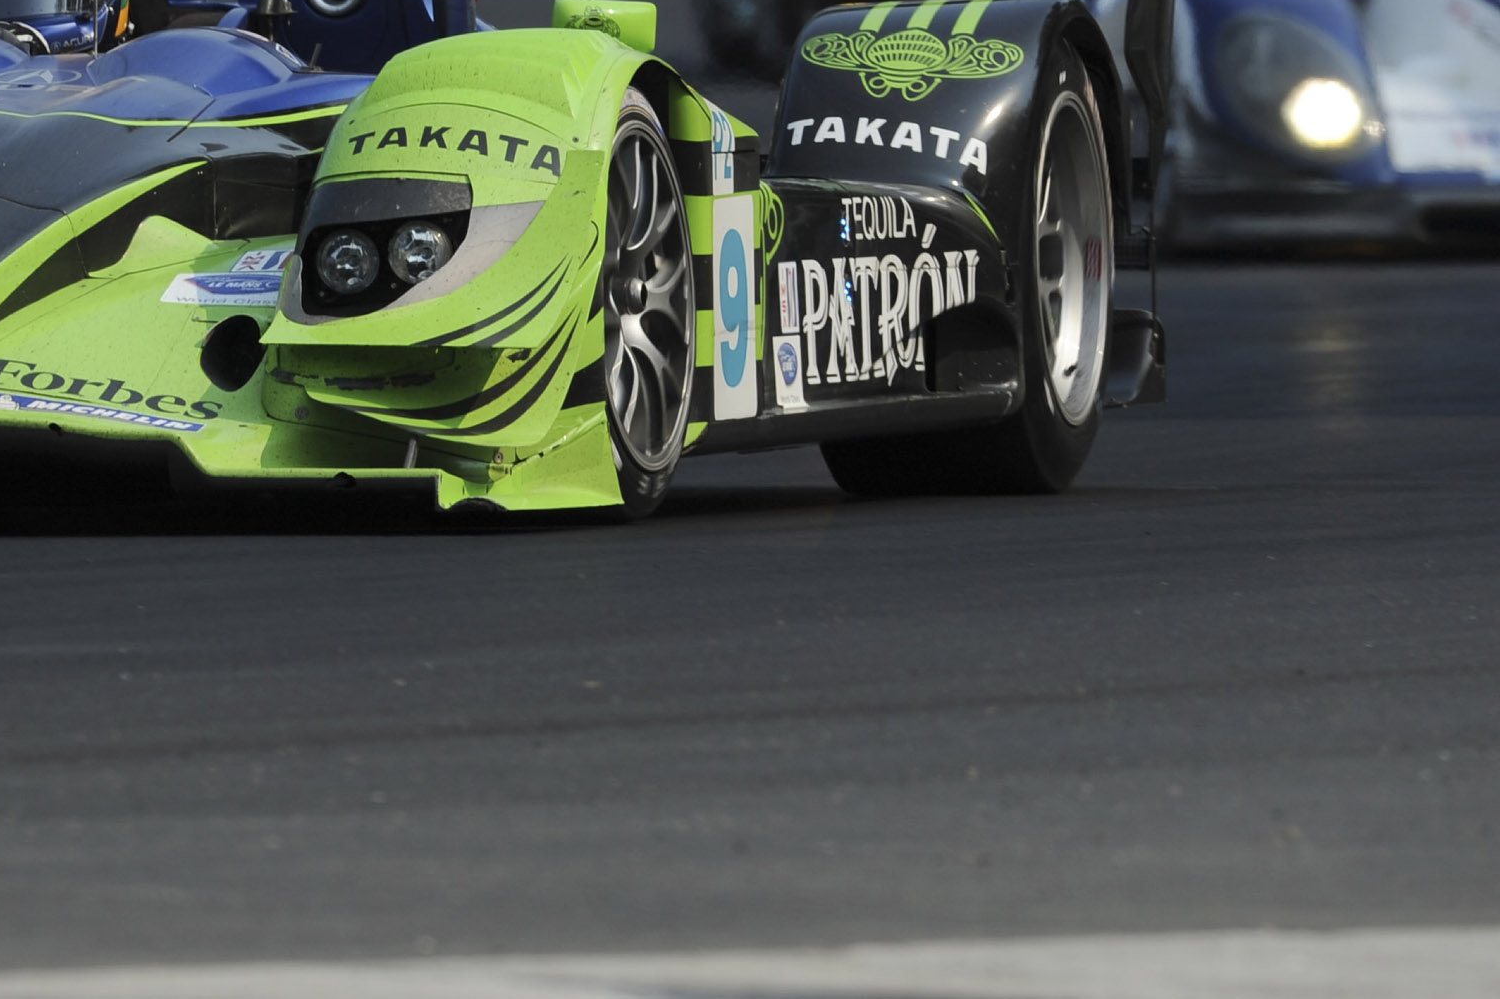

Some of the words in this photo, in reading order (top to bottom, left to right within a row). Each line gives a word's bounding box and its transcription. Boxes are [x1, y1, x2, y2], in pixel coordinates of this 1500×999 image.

[348, 125, 561, 177] TAKATA
[711, 110, 733, 180] P2
[787, 116, 987, 175] TAKATA
[840, 196, 917, 241] TEQUILA
[719, 228, 748, 388] 9
[25, 400, 193, 430] MICHELIN
